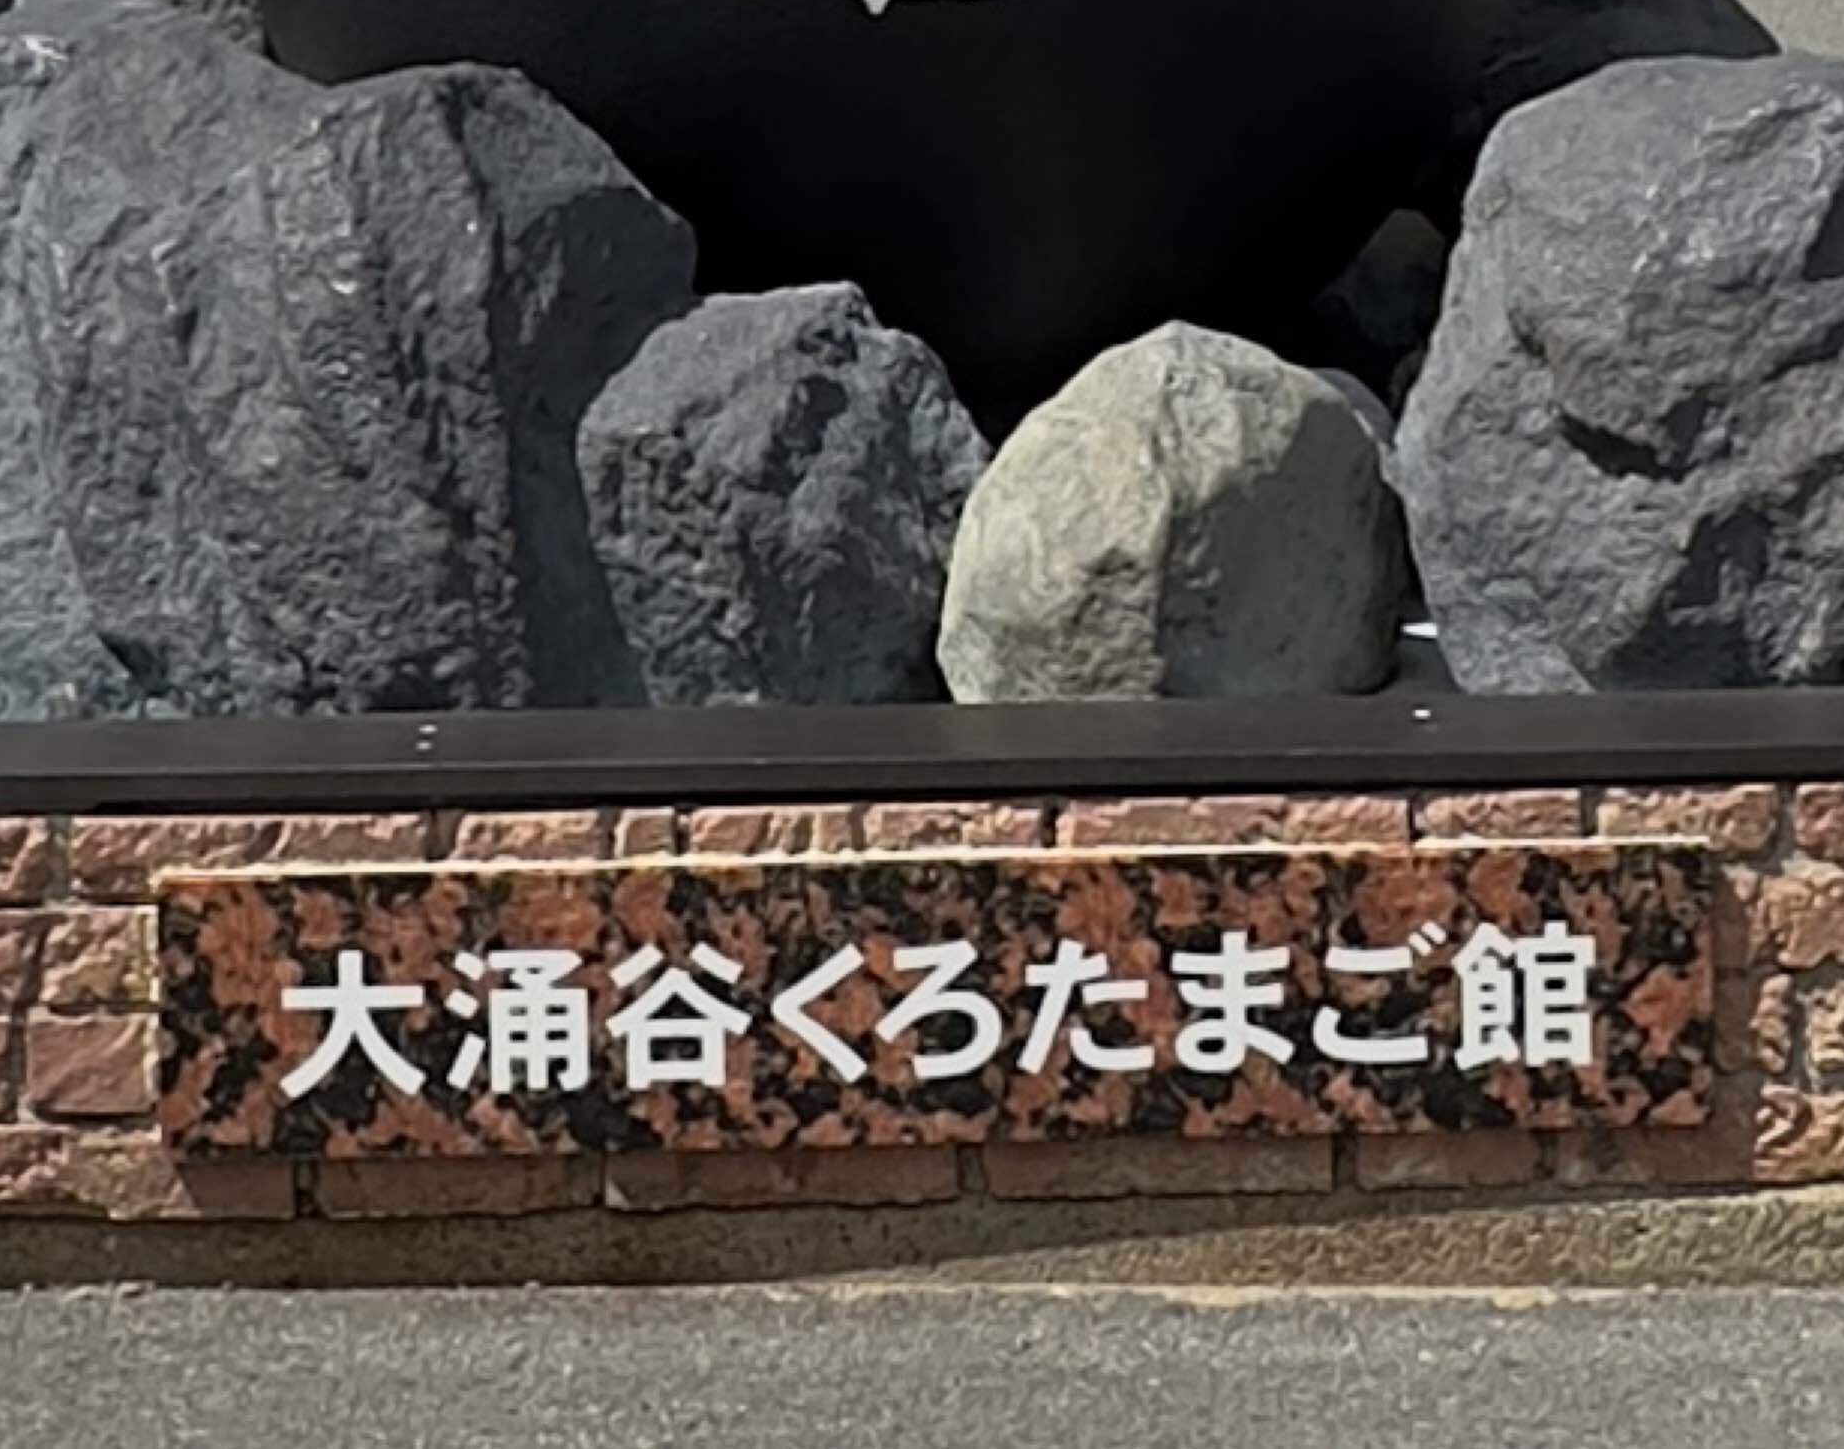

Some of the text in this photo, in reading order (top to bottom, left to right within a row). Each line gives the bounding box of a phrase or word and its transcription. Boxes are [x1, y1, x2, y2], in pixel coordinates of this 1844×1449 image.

[279, 920, 1597, 1098] 大涌谷くろたまご館
